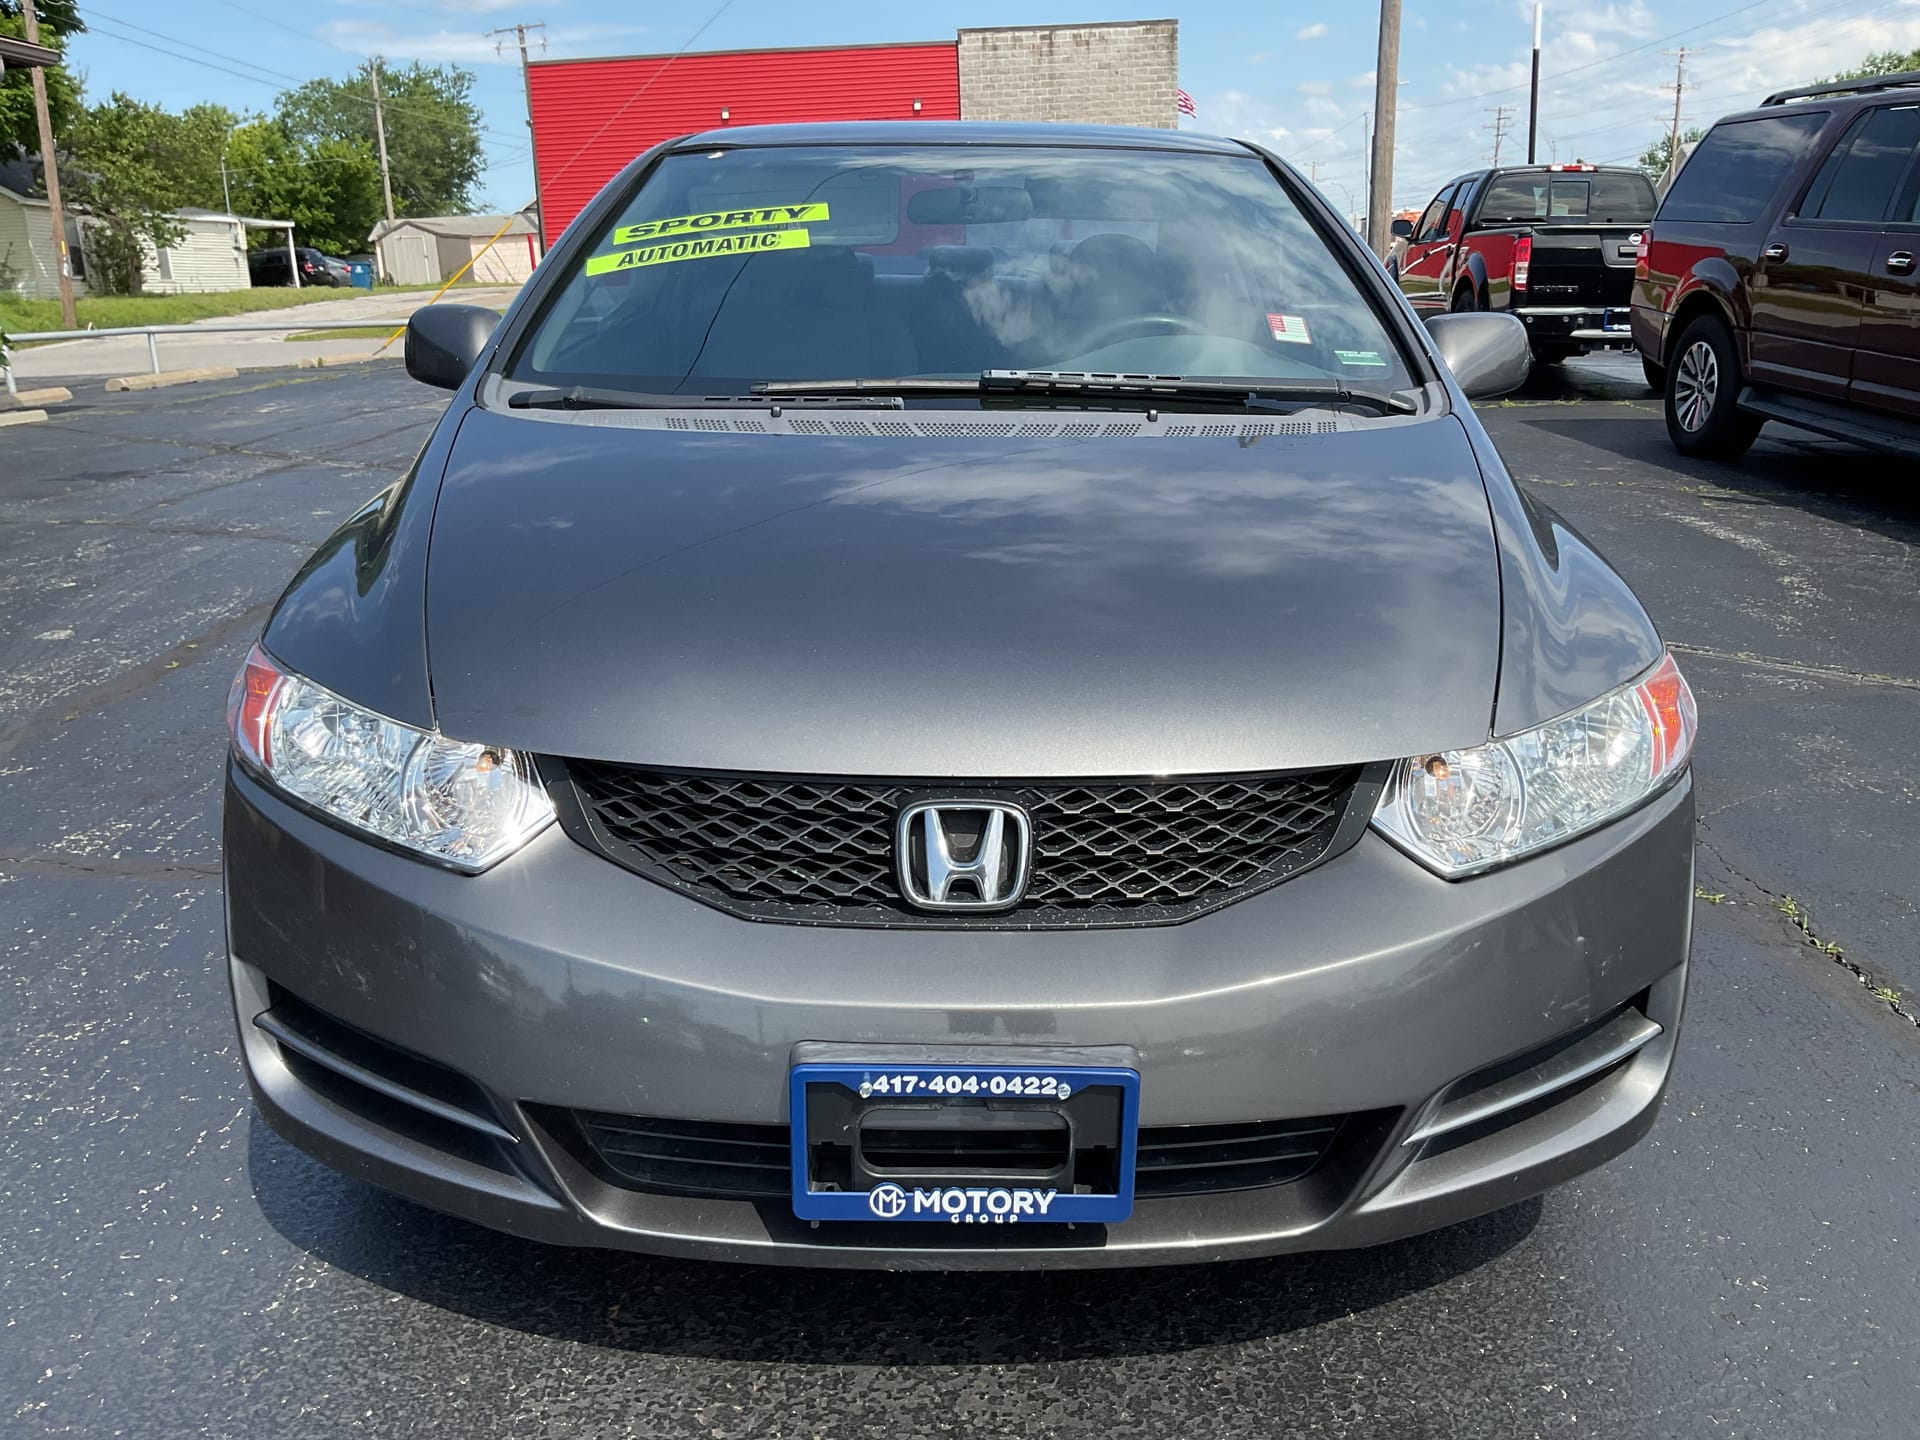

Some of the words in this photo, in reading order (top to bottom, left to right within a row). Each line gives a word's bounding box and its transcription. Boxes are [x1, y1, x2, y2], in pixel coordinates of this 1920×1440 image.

[626, 206, 813, 239] SPORTY
[616, 233, 780, 268] AUTOMATIC
[913, 1188, 1057, 1215] MOTORY
[950, 1213, 1019, 1224] GROUP
